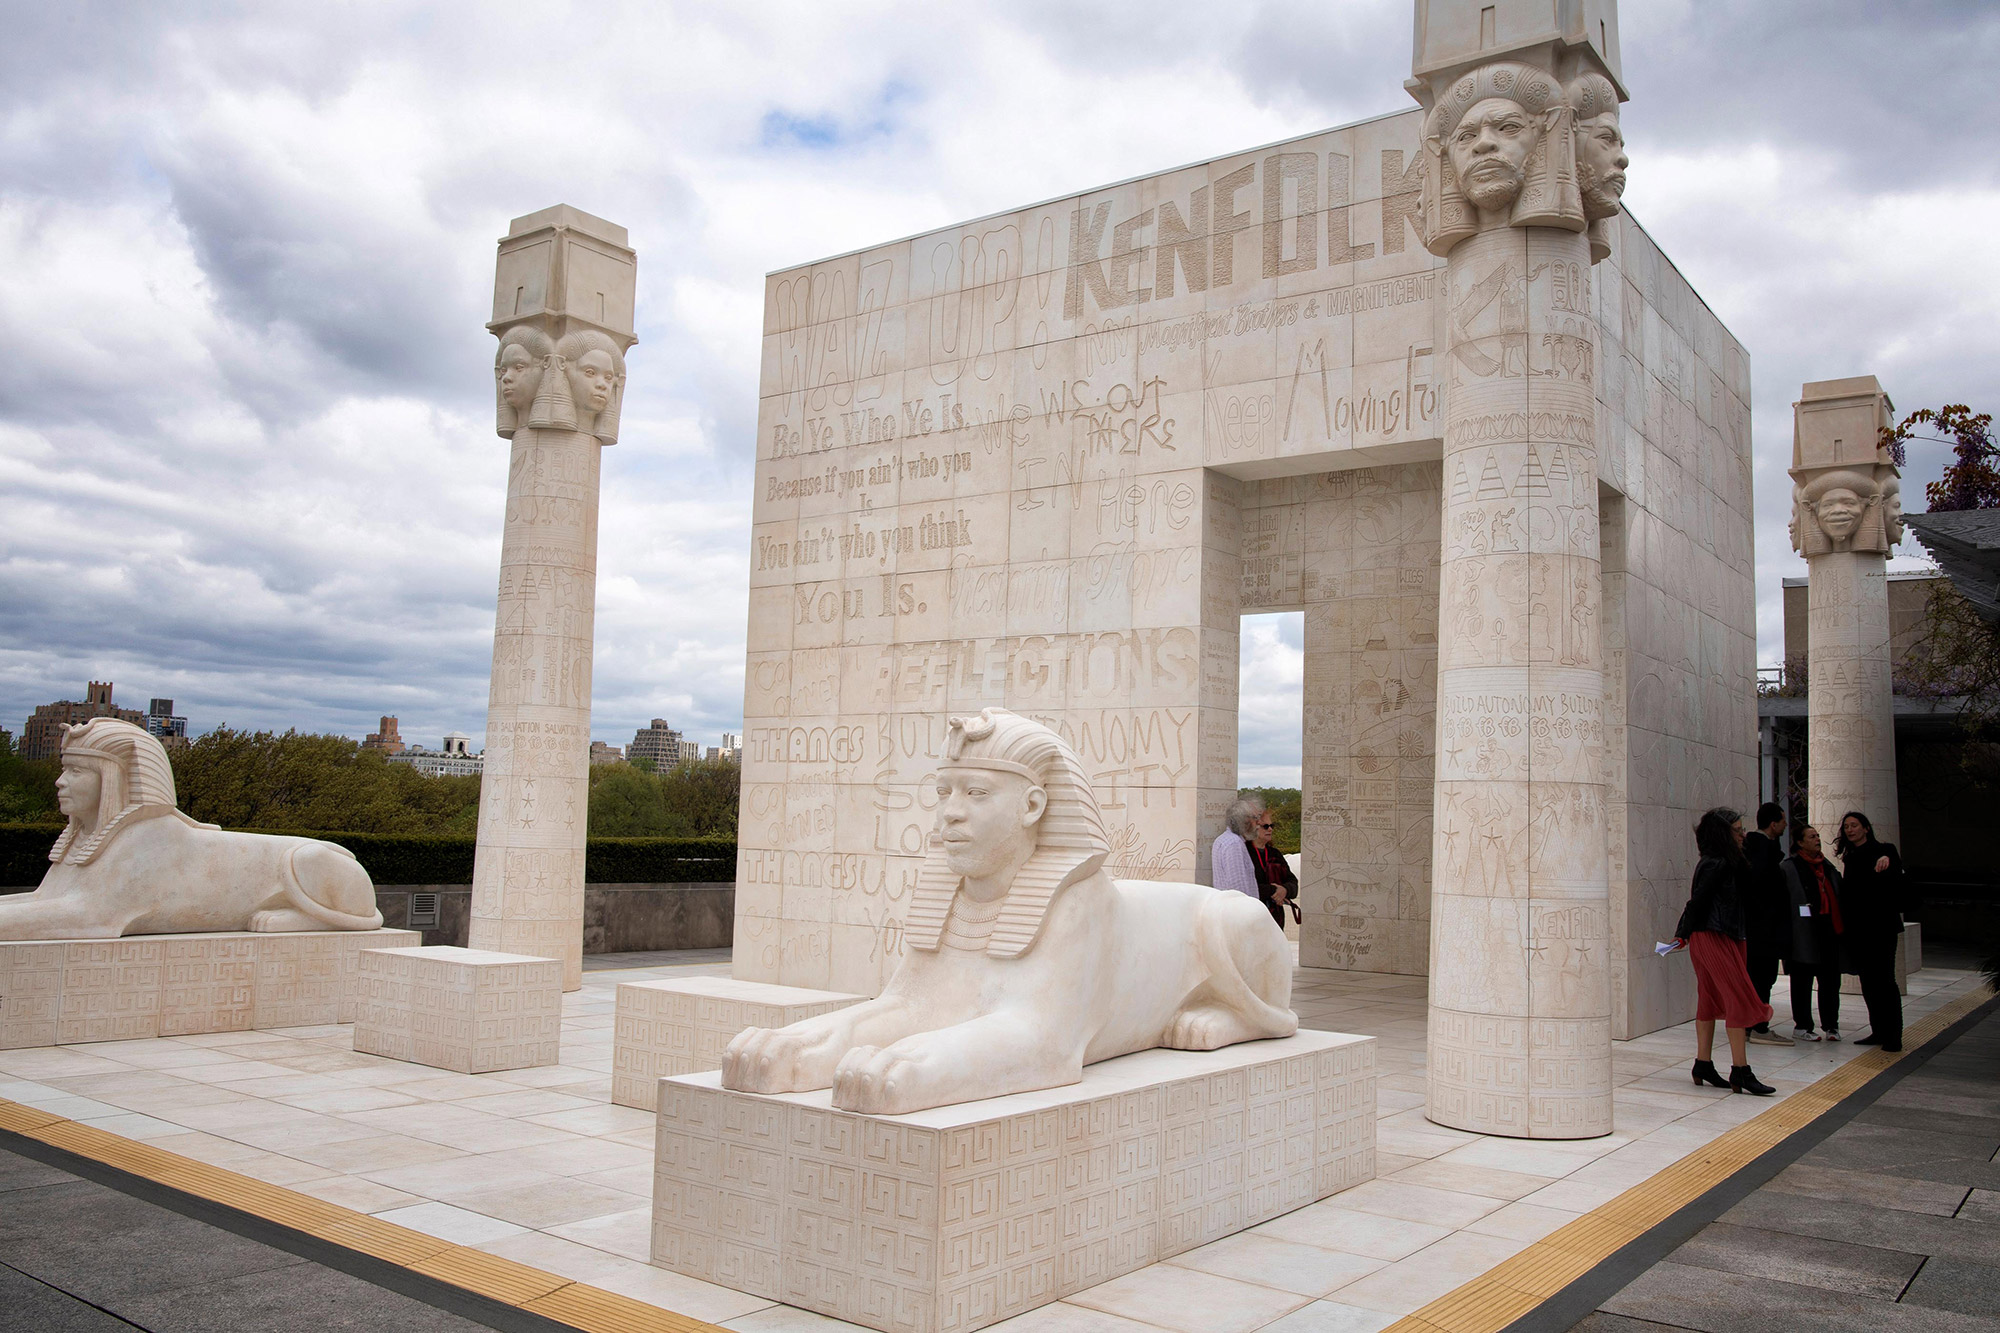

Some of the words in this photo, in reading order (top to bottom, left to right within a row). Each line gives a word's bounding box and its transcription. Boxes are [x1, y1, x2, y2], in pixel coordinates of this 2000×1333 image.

[1140, 310, 1233, 355] Magnificent
[1235, 302, 1299, 337] Brothers
[1327, 274, 1436, 317] MAGNIFICENT
[770, 423, 800, 461] Be
[806, 416, 834, 456] Ye
[840, 408, 897, 449] Who
[902, 399, 933, 439] Ye
[939, 394, 971, 434] Is.
[766, 476, 822, 502] Because
[825, 466, 838, 494] if
[838, 468, 864, 499] you
[868, 455, 903, 486] ain't
[907, 452, 939, 480] who
[943, 451, 972, 483] you
[859, 493, 873, 517] Is
[758, 535, 789, 572] You
[793, 527, 835, 566] ain't
[838, 523, 876, 561] who
[880, 526, 915, 567] you
[919, 509, 973, 551] think
[1399, 569, 1424, 584] WIGS
[795, 582, 864, 625] You
[878, 574, 928, 618] Is.
[868, 627, 1200, 703] REFLECTIONS
[1477, 693, 1556, 717] AUTONOMY
[500, 721, 541, 734] SALVATION
[544, 723, 582, 737] SALVATION
[751, 726, 864, 764] THANGS
[1356, 781, 1367, 796] MY
[1370, 782, 1392, 797] HOPE
[744, 850, 858, 891] THANGS
